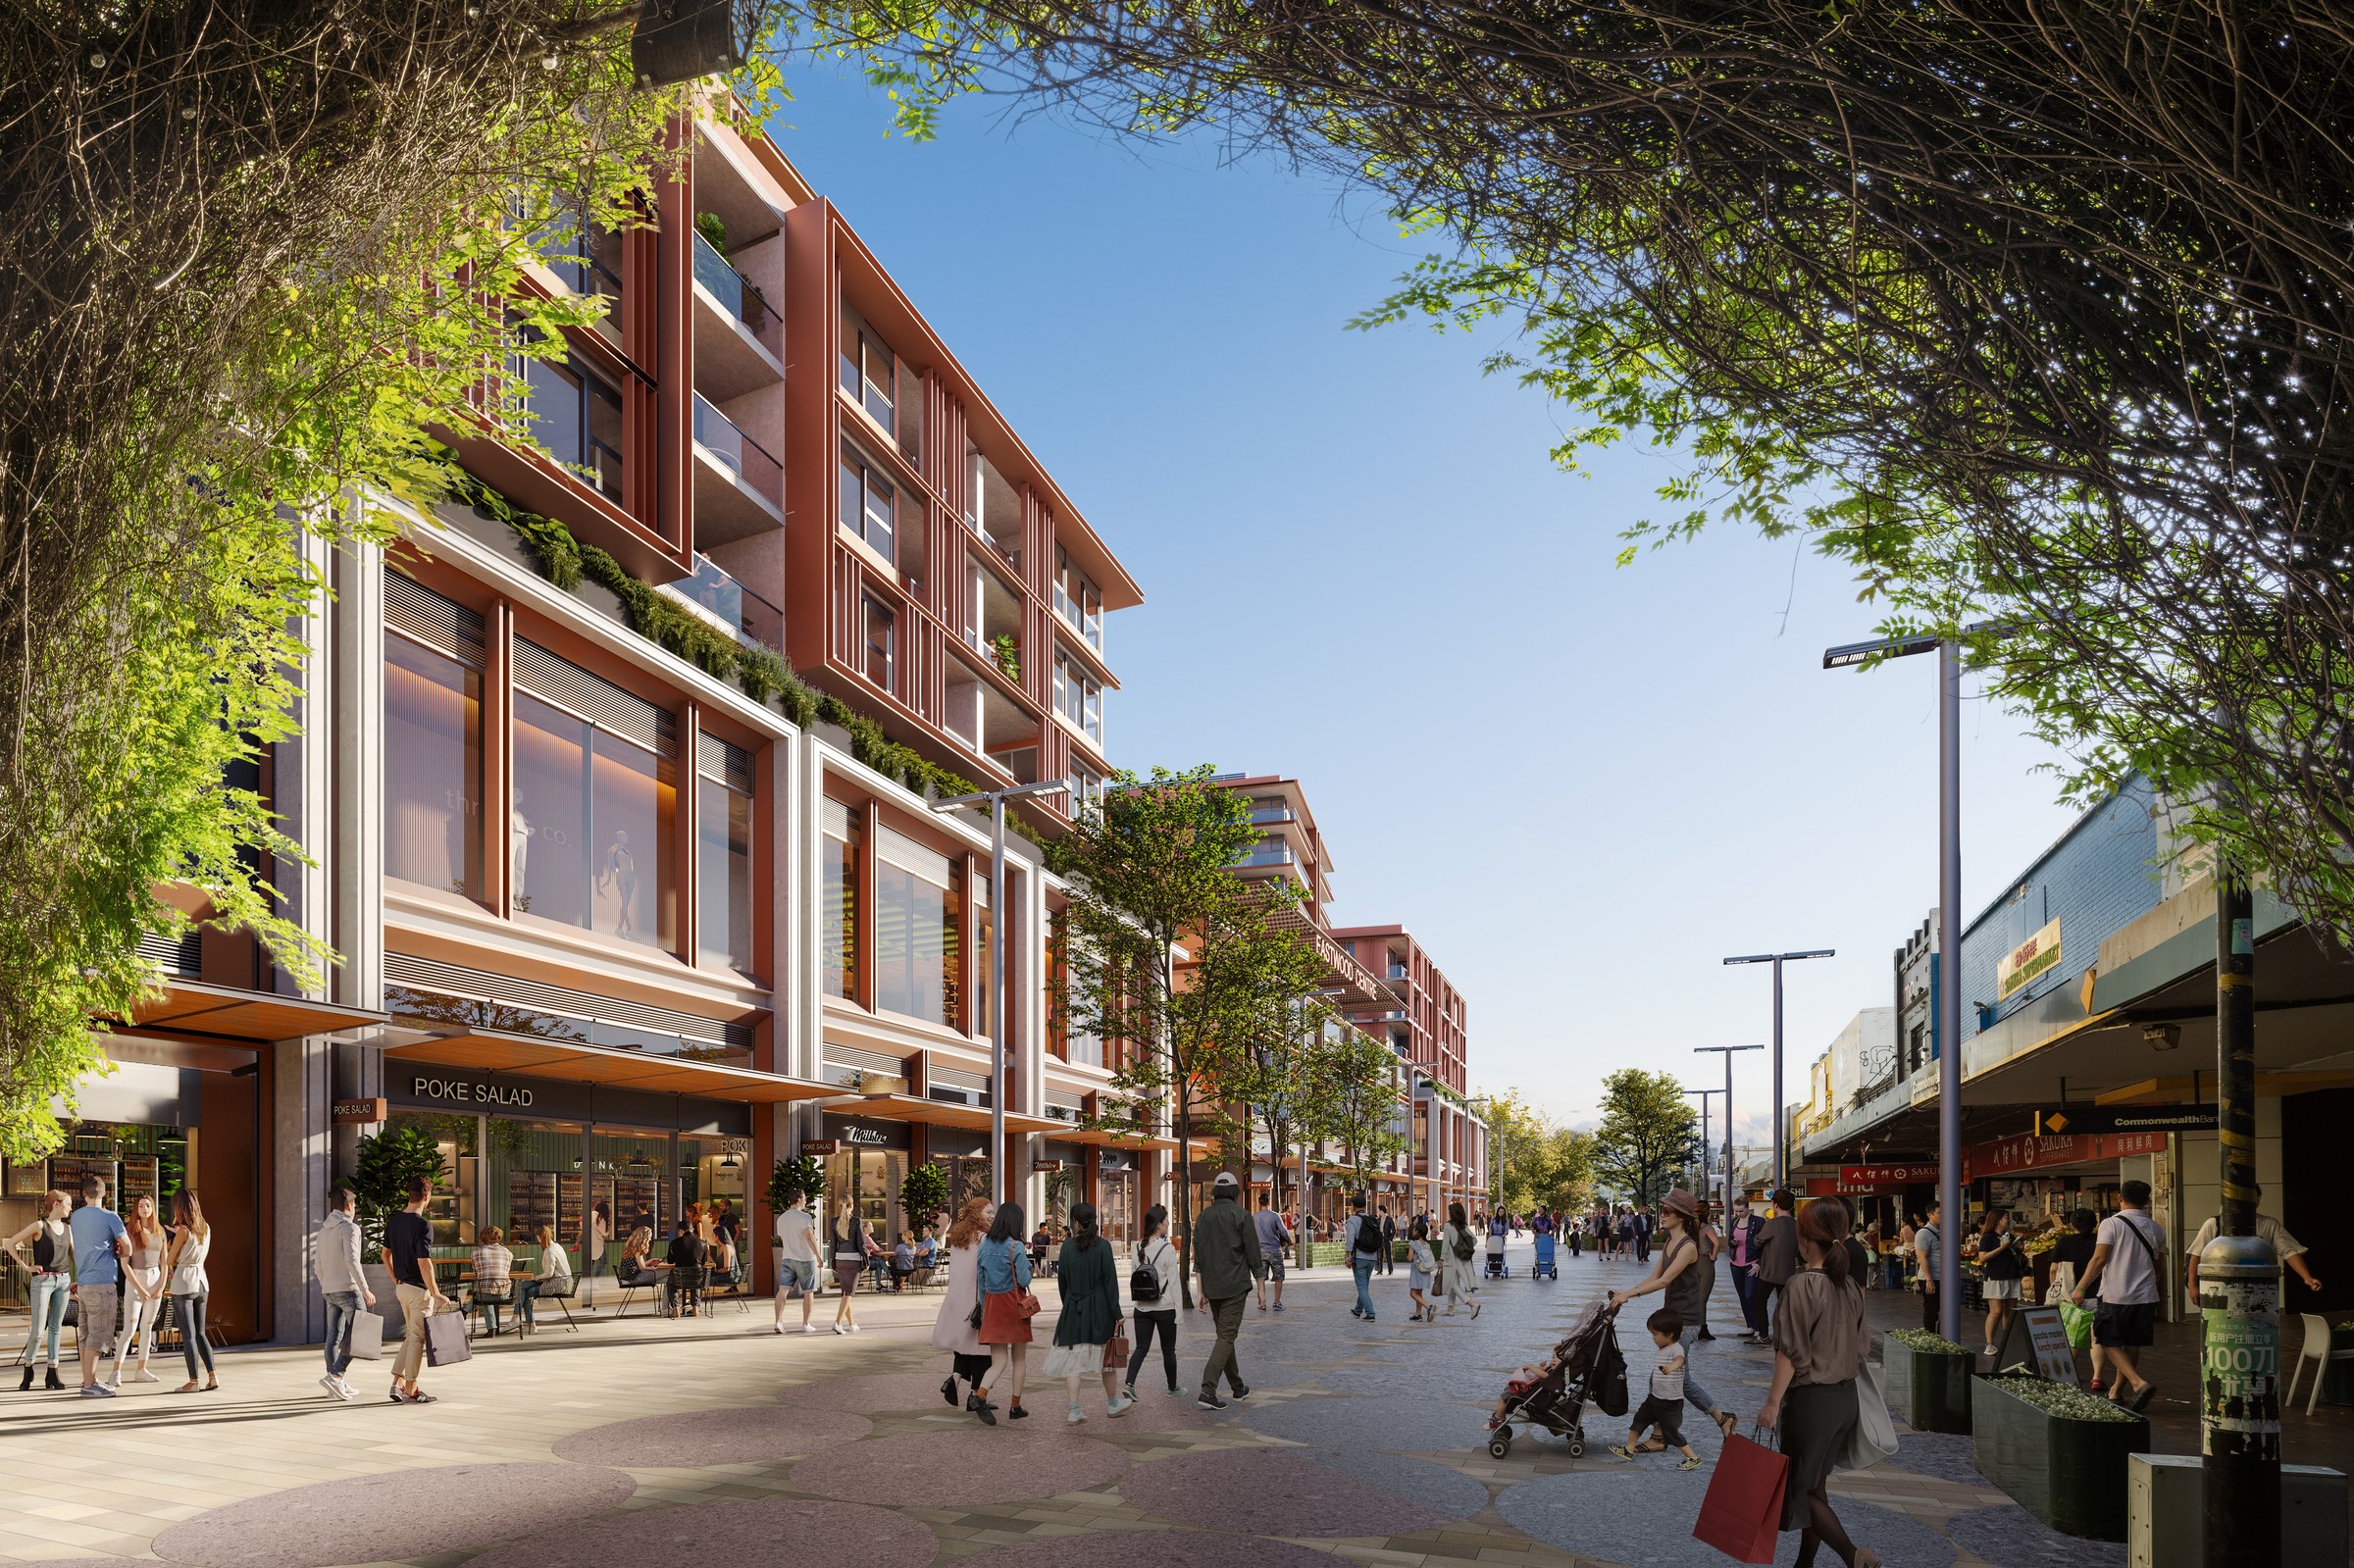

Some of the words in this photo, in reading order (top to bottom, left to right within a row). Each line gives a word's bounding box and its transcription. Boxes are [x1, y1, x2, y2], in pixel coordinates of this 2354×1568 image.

[1316, 935, 1354, 981] EASTWOOD
[1356, 969, 1377, 1000] CENTRE
[415, 1078, 469, 1100] POKE
[475, 1085, 533, 1106] SALAD
[333, 1105, 350, 1115] POKE
[351, 1104, 371, 1114] SALAD
[2115, 1115, 2220, 1127] CommonwealthBan
[2040, 1136, 2073, 1152] SAKURA
